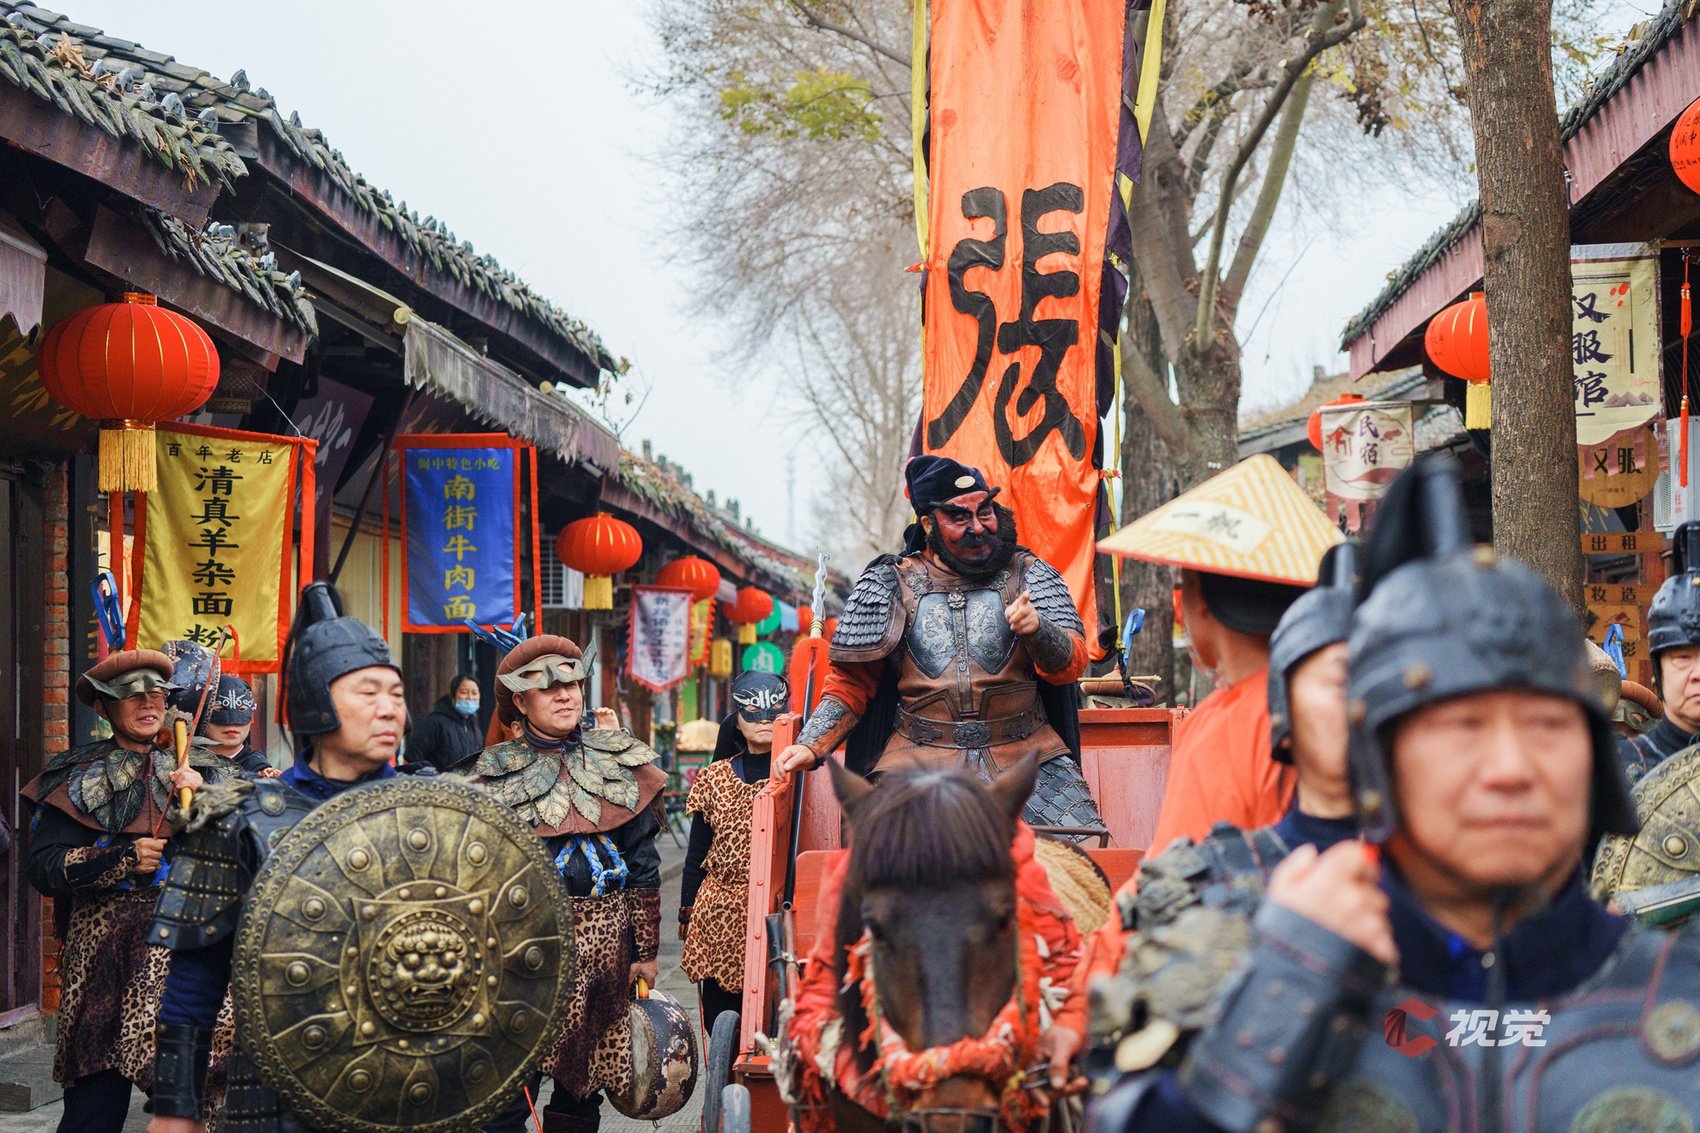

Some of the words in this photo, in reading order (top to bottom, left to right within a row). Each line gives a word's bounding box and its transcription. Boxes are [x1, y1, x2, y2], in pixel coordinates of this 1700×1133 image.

[166, 443, 274, 465] 百年老店
[1359, 415, 1380, 465] 民宿
[183, 465, 244, 651] 清真羊杂面粉
[441, 474, 479, 620] 南街牛肉面
[1591, 535, 1637, 551] 出租
[1591, 586, 1637, 603] 妆造
